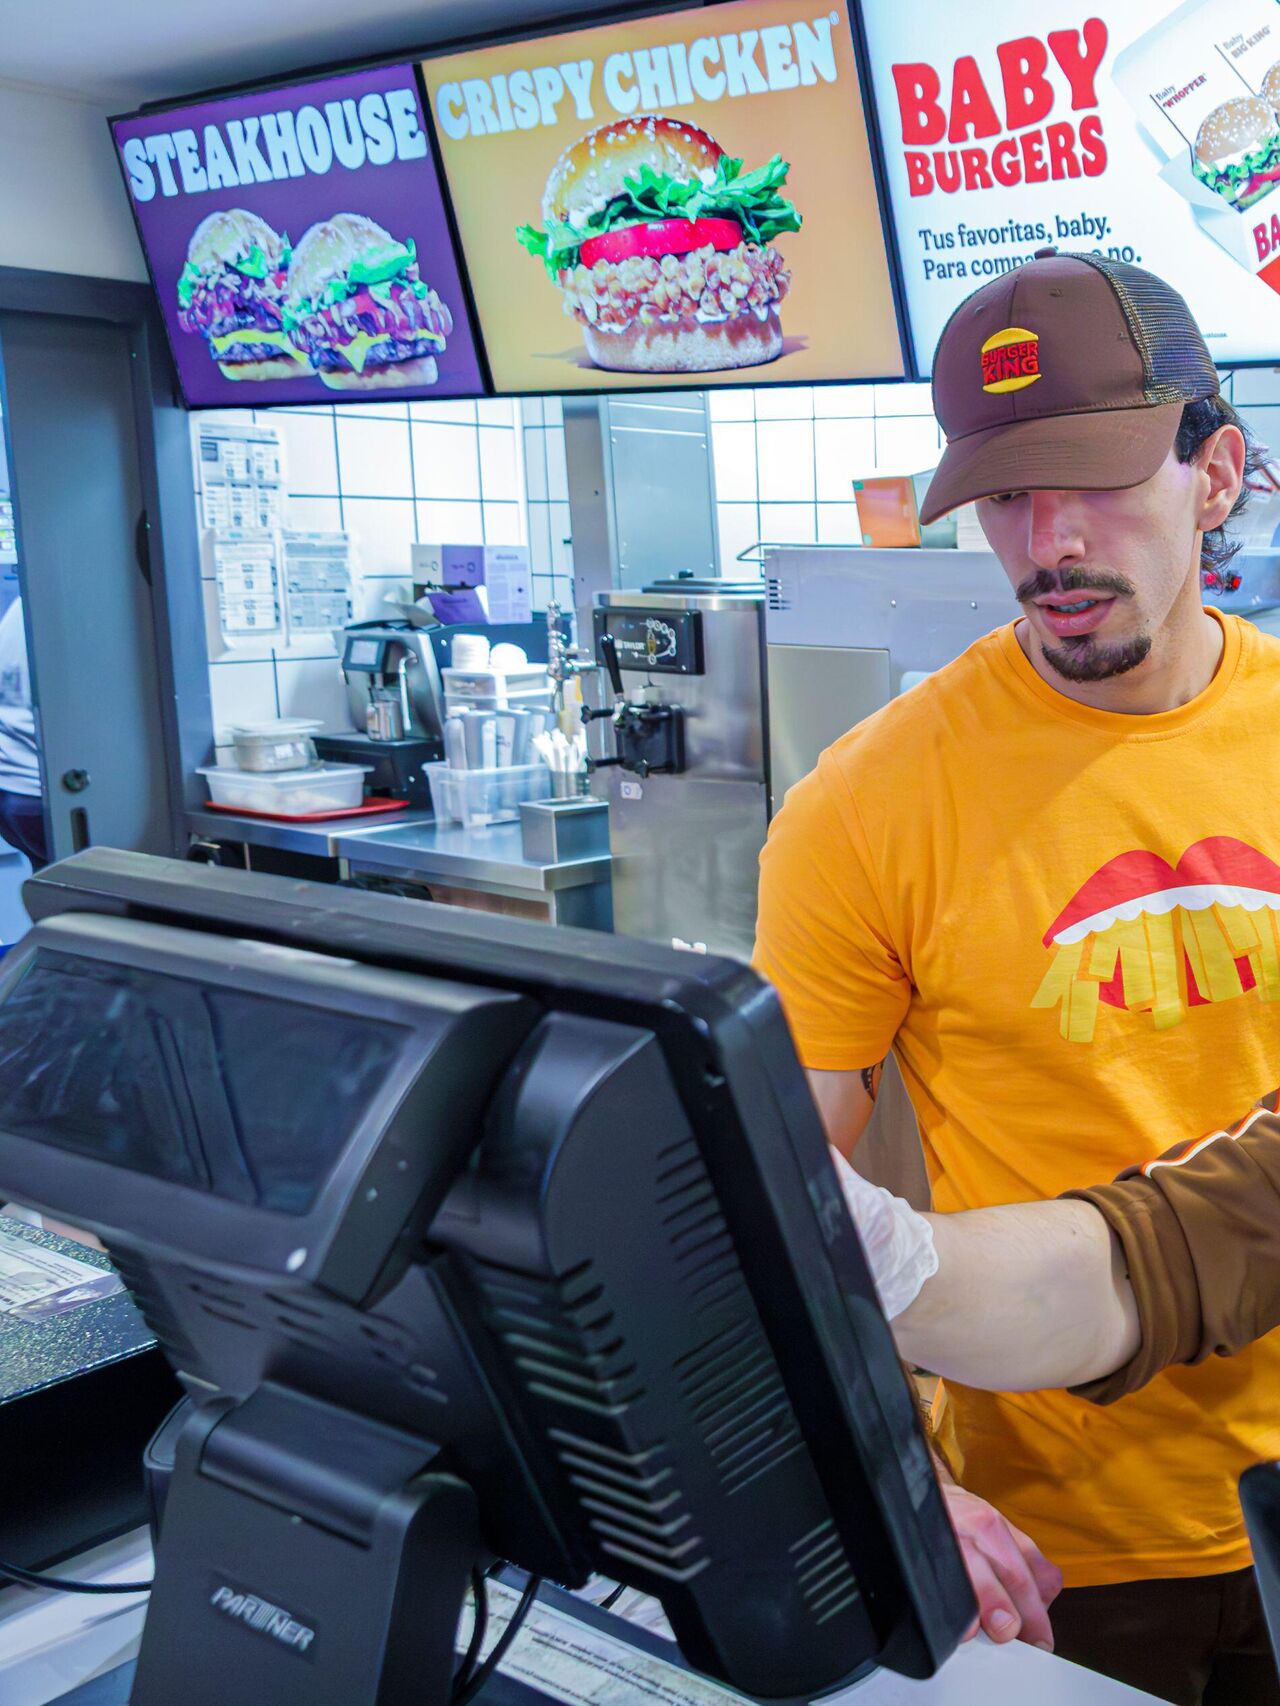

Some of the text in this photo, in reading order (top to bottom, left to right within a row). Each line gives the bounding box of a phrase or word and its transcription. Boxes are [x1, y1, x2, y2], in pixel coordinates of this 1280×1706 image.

[436, 18, 838, 140] CRISPY CHICKEN
[891, 17, 1109, 146] BABY
[1155, 84, 1177, 101] Baby
[123, 89, 428, 201] STEAKHOUSE
[902, 115, 1109, 198] BURGERS
[919, 212, 1112, 251] Tus favoritas, baby.
[924, 258, 967, 280] Para
[981, 341, 1039, 368] BURGER
[983, 355, 1040, 385] KING
[210, 1586, 315, 1651] PARTNER
